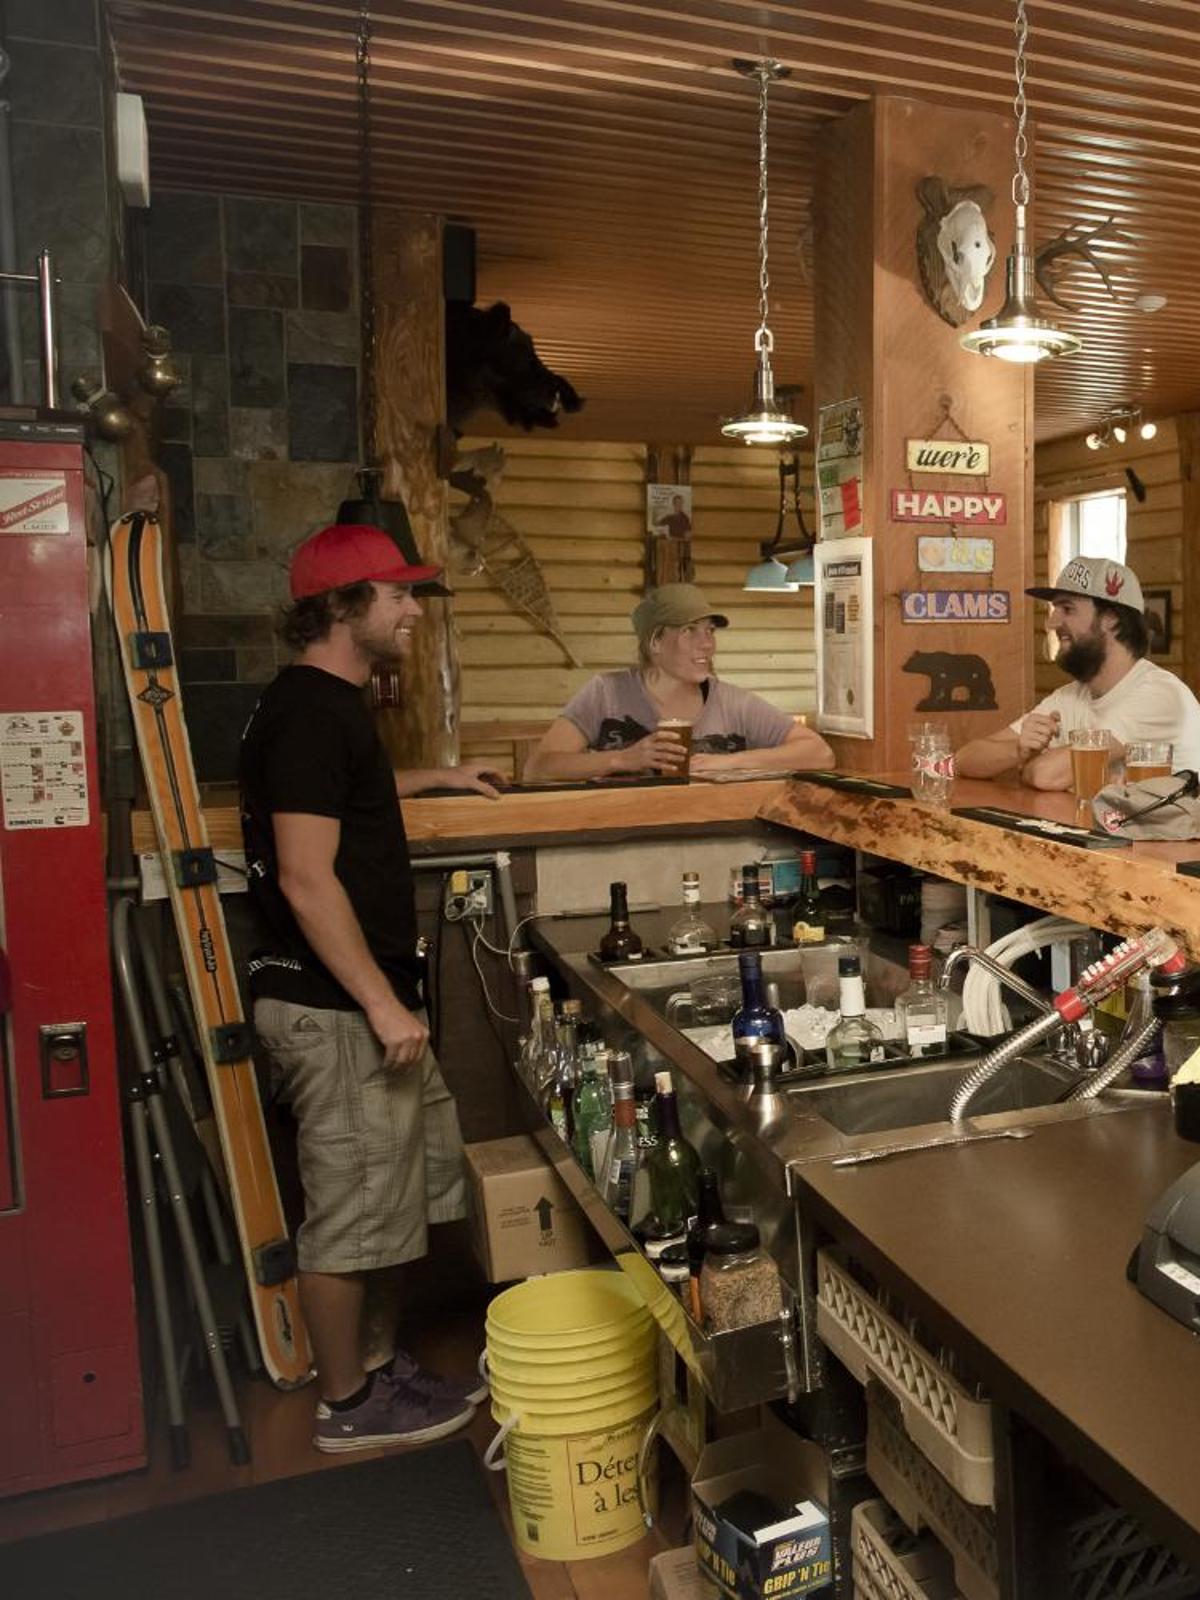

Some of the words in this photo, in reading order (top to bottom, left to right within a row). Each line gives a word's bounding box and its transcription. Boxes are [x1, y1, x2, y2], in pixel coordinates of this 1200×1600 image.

[896, 492, 1004, 520] HAPPY
[904, 592, 1008, 619] CLAMS
[594, 1491, 608, 1512] à
[763, 1570, 797, 1595] GRIP
